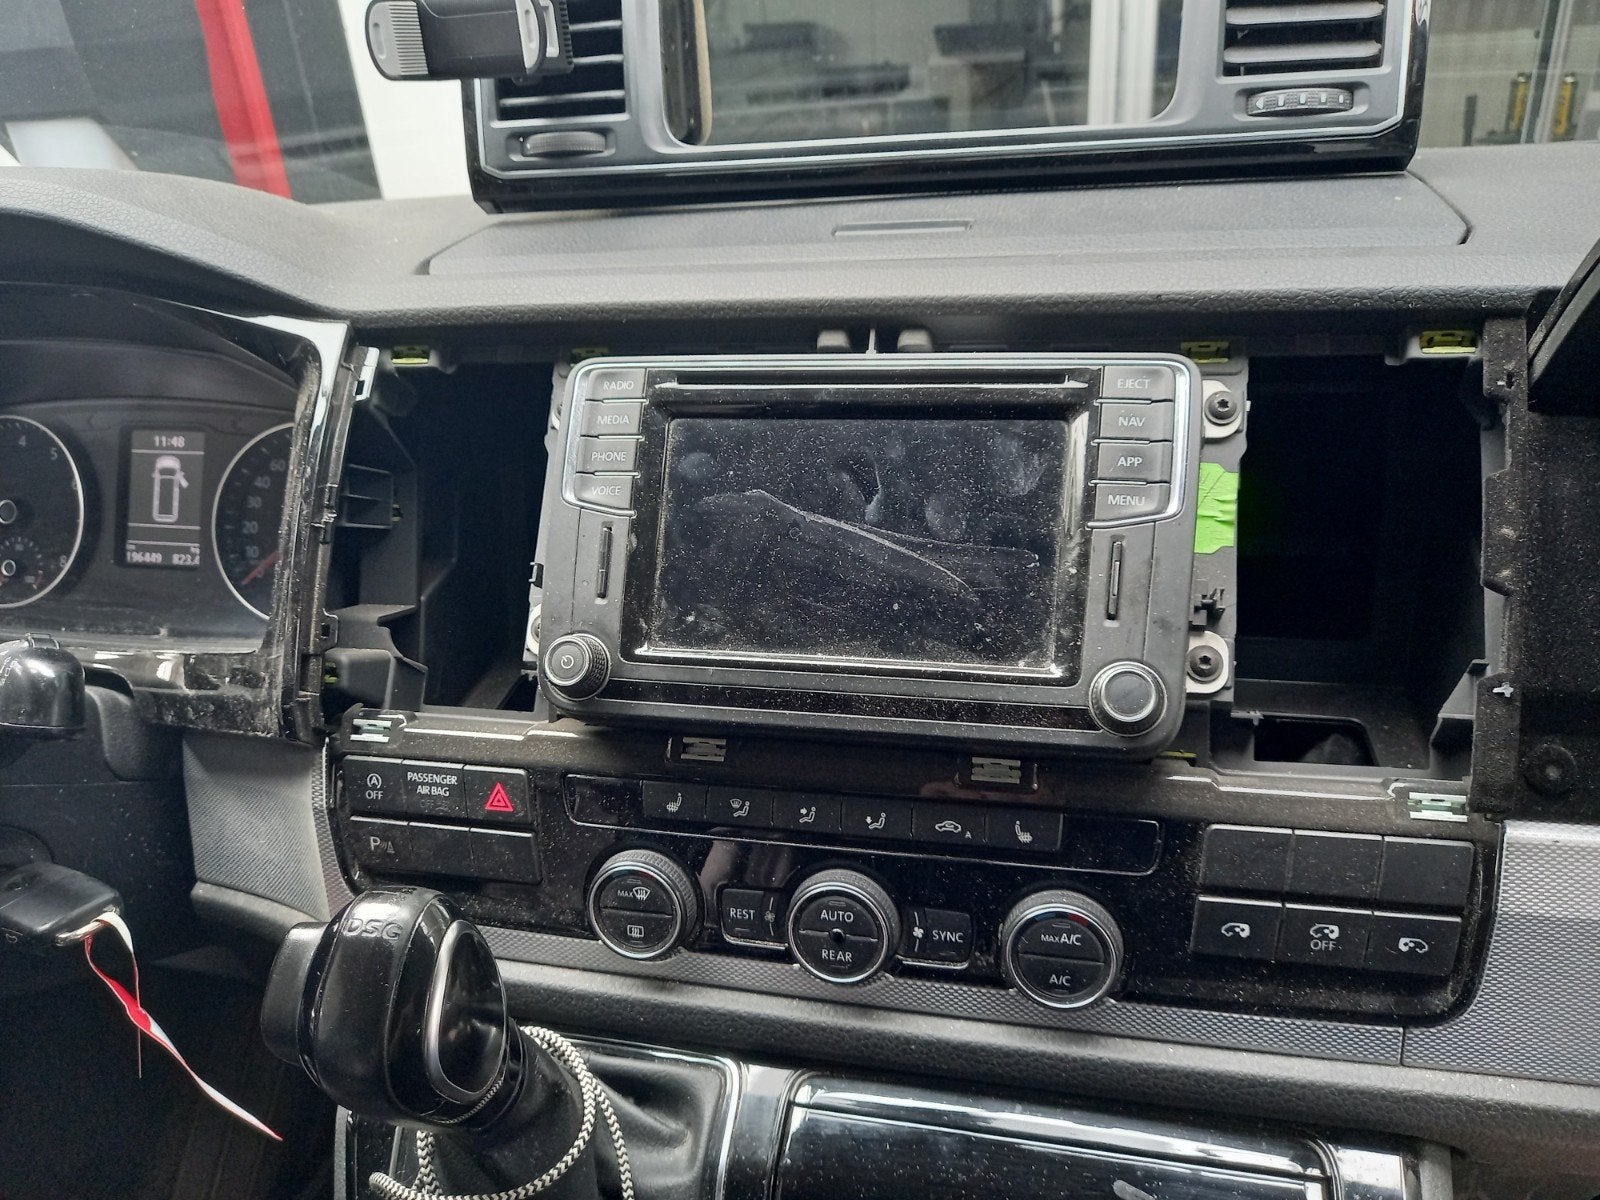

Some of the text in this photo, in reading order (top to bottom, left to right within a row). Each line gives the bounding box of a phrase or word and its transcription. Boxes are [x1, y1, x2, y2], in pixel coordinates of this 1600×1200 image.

[603, 381, 634, 390] RADIO
[1117, 379, 1151, 389] EJECT
[597, 415, 630, 425] MEDIA
[1118, 417, 1145, 427] NAV
[18, 434, 27, 447] 4
[154, 435, 186, 447] 11:48
[50, 448, 58, 460] 5
[591, 452, 627, 461] PHONE
[269, 459, 286, 472] 60
[1117, 457, 1143, 467] APP
[254, 476, 271, 489] 40
[591, 486, 622, 495] VOICE
[1108, 495, 1145, 505] MENU
[242, 520, 259, 534] 20
[407, 771, 458, 785] PASSENGER
[365, 789, 384, 800] OFF
[416, 785, 450, 797] AIR BAG
[965, 831, 972, 839] A
[617, 889, 633, 898] MAX
[729, 907, 755, 921] REST
[820, 908, 854, 923] AUTO
[343, 918, 403, 940] DSG
[932, 929, 964, 943] SYNC
[1041, 933, 1082, 947] MAX A/C
[1310, 939, 1336, 951] OFF
[821, 948, 853, 962] REAR
[1049, 973, 1071, 987] A/C
